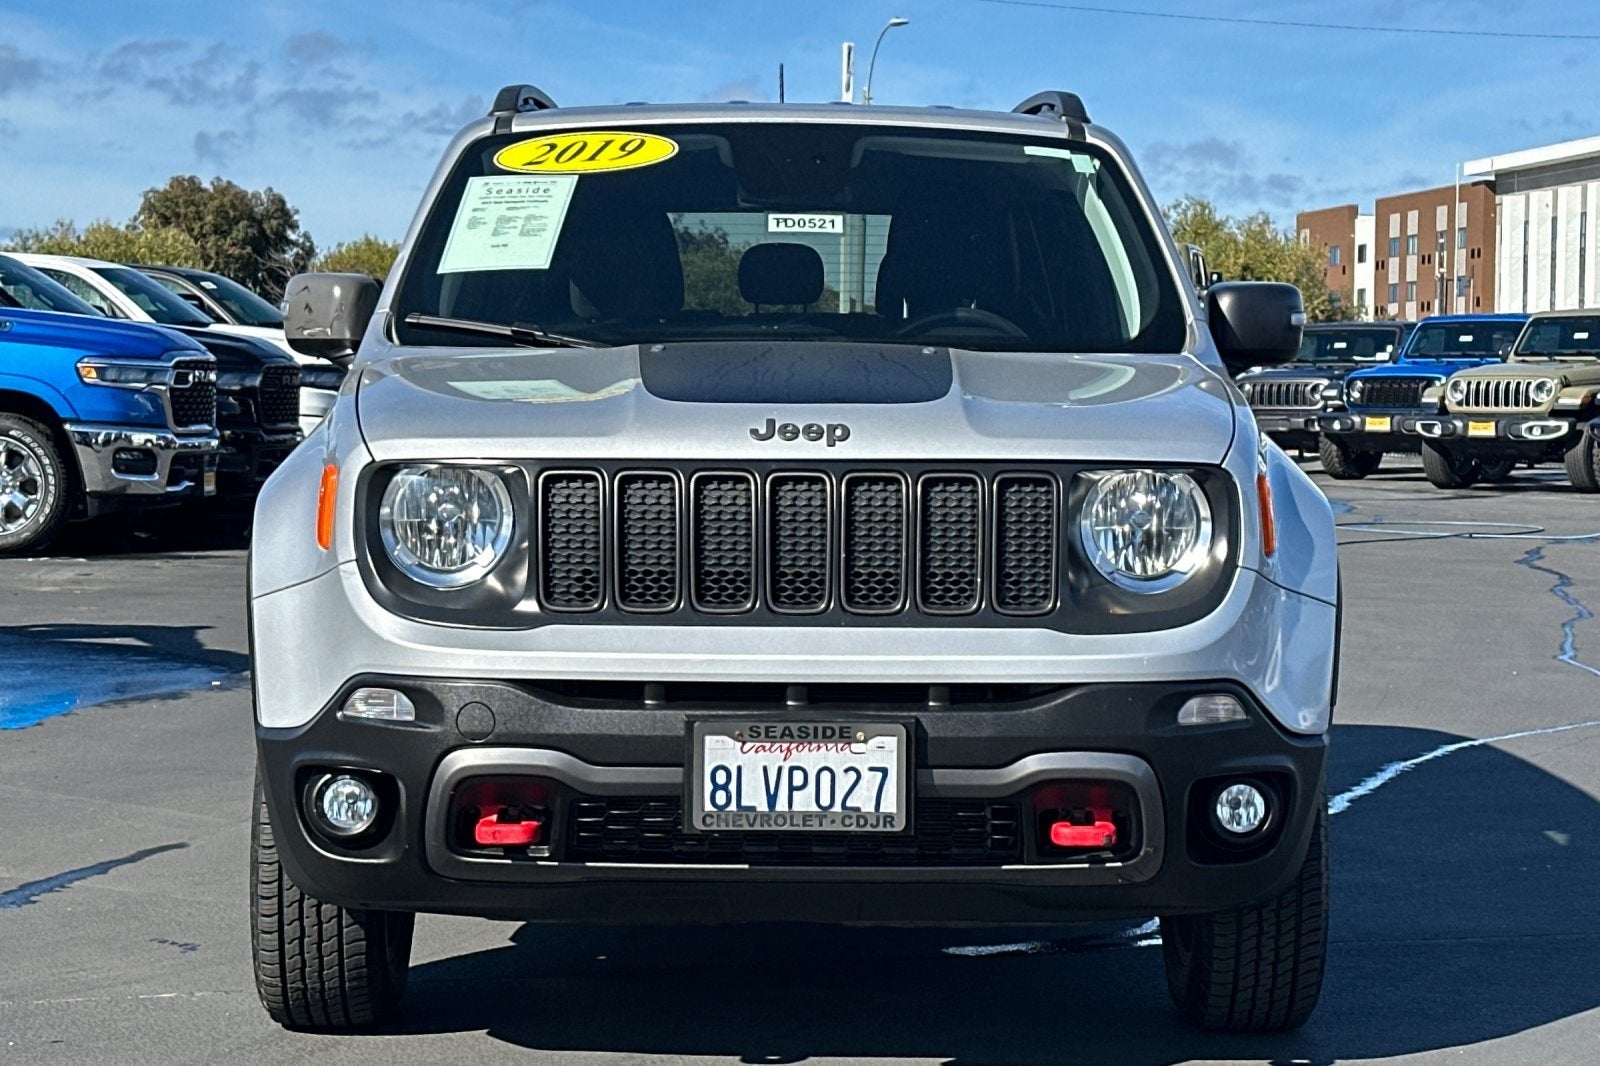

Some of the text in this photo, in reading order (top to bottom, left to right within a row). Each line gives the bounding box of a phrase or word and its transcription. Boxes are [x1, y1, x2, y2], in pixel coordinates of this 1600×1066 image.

[521, 138, 647, 167] 2019
[486, 187, 550, 195] Seaside
[772, 217, 835, 229] TD0521
[749, 418, 851, 447] Jeep
[748, 725, 852, 739] SEASIDE
[740, 741, 866, 762] California
[709, 764, 889, 812] 8LVP027
[701, 813, 896, 829] CHEVROLET CDJR
